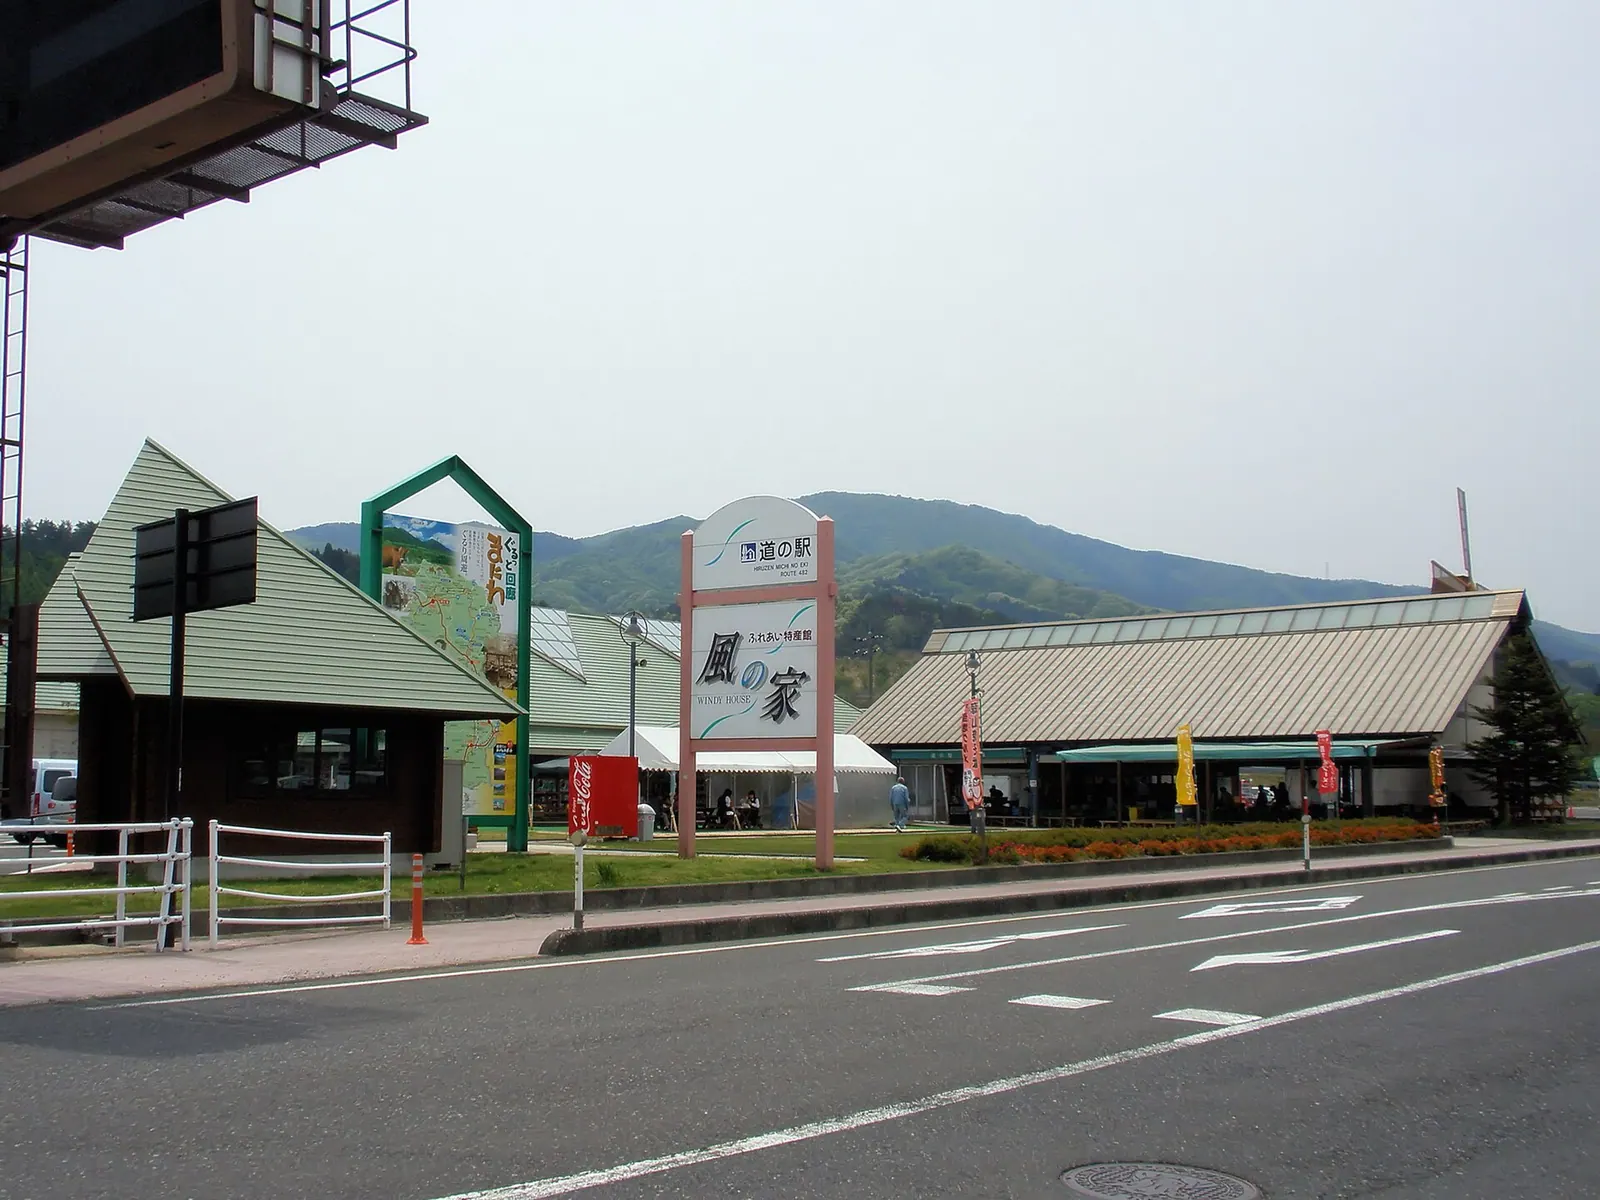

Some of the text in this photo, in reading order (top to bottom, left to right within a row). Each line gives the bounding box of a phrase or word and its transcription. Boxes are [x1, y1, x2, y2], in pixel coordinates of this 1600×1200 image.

[759, 537, 812, 562] 道の駅
[753, 564, 774, 572] HIRUZEN
[775, 563, 790, 571] MICHI
[748, 629, 812, 643] ふれあい特産館
[695, 631, 811, 724] 風の家
[697, 695, 751, 705] WINDY HOUSE
